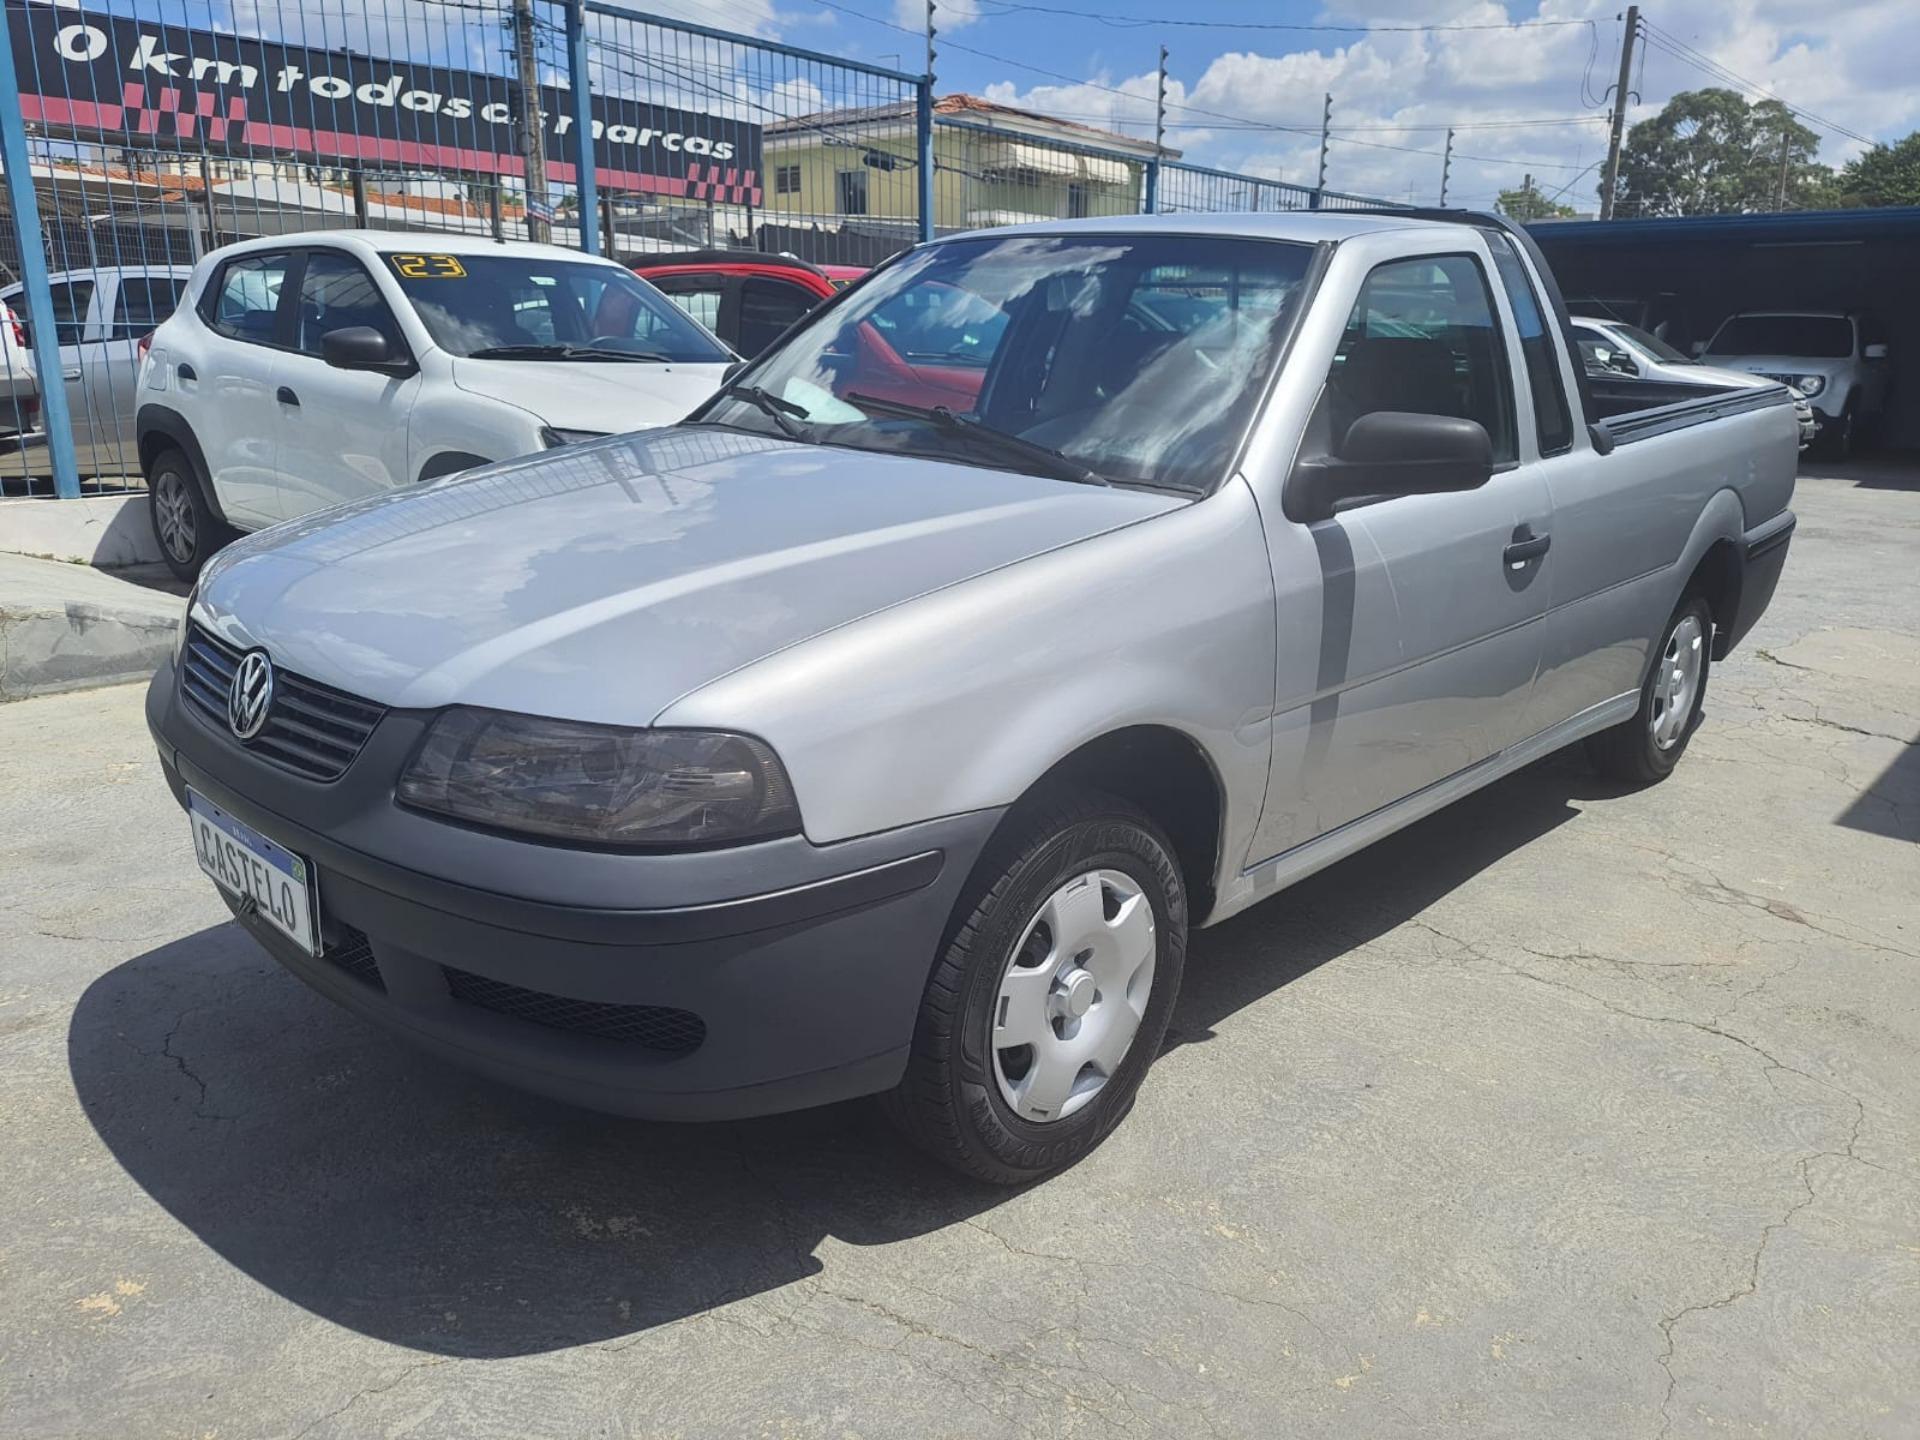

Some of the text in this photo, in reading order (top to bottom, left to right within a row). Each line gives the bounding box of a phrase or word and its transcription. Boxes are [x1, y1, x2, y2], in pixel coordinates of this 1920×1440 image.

[129, 35, 258, 89] km
[276, 65, 474, 119] todas
[554, 113, 736, 160] marcas
[400, 256, 461, 275] 23
[200, 822, 296, 932] CASTELO
